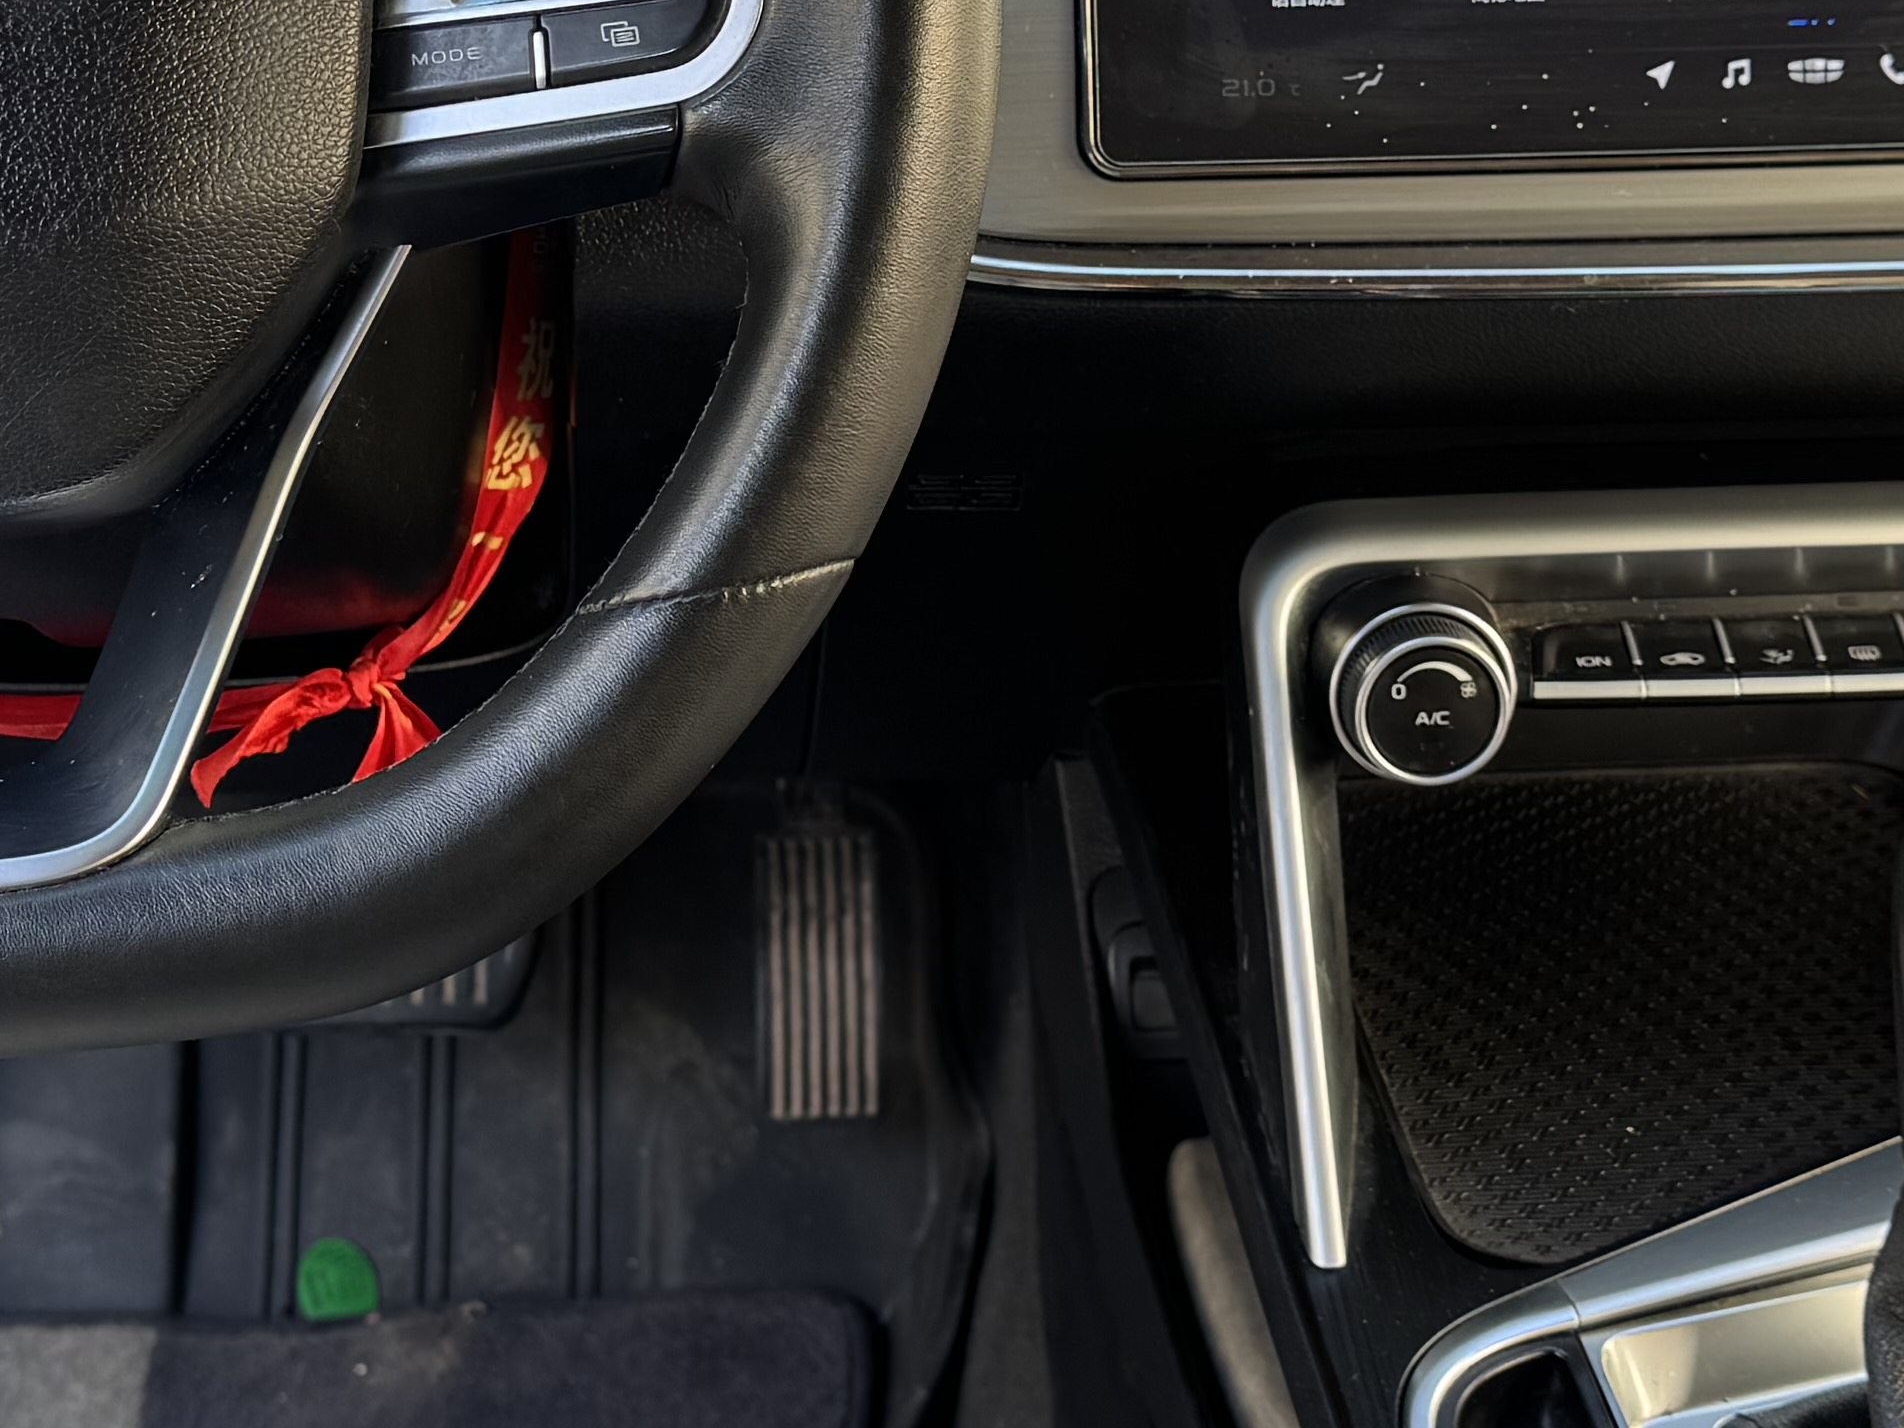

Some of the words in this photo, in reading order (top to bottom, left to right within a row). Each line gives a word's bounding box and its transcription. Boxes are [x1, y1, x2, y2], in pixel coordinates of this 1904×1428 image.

[411, 46, 481, 66] MODE
[1222, 79, 1275, 97] 21.0
[1576, 655, 1611, 668] ION
[1391, 684, 1406, 700] 0
[1415, 710, 1450, 726] A/C
